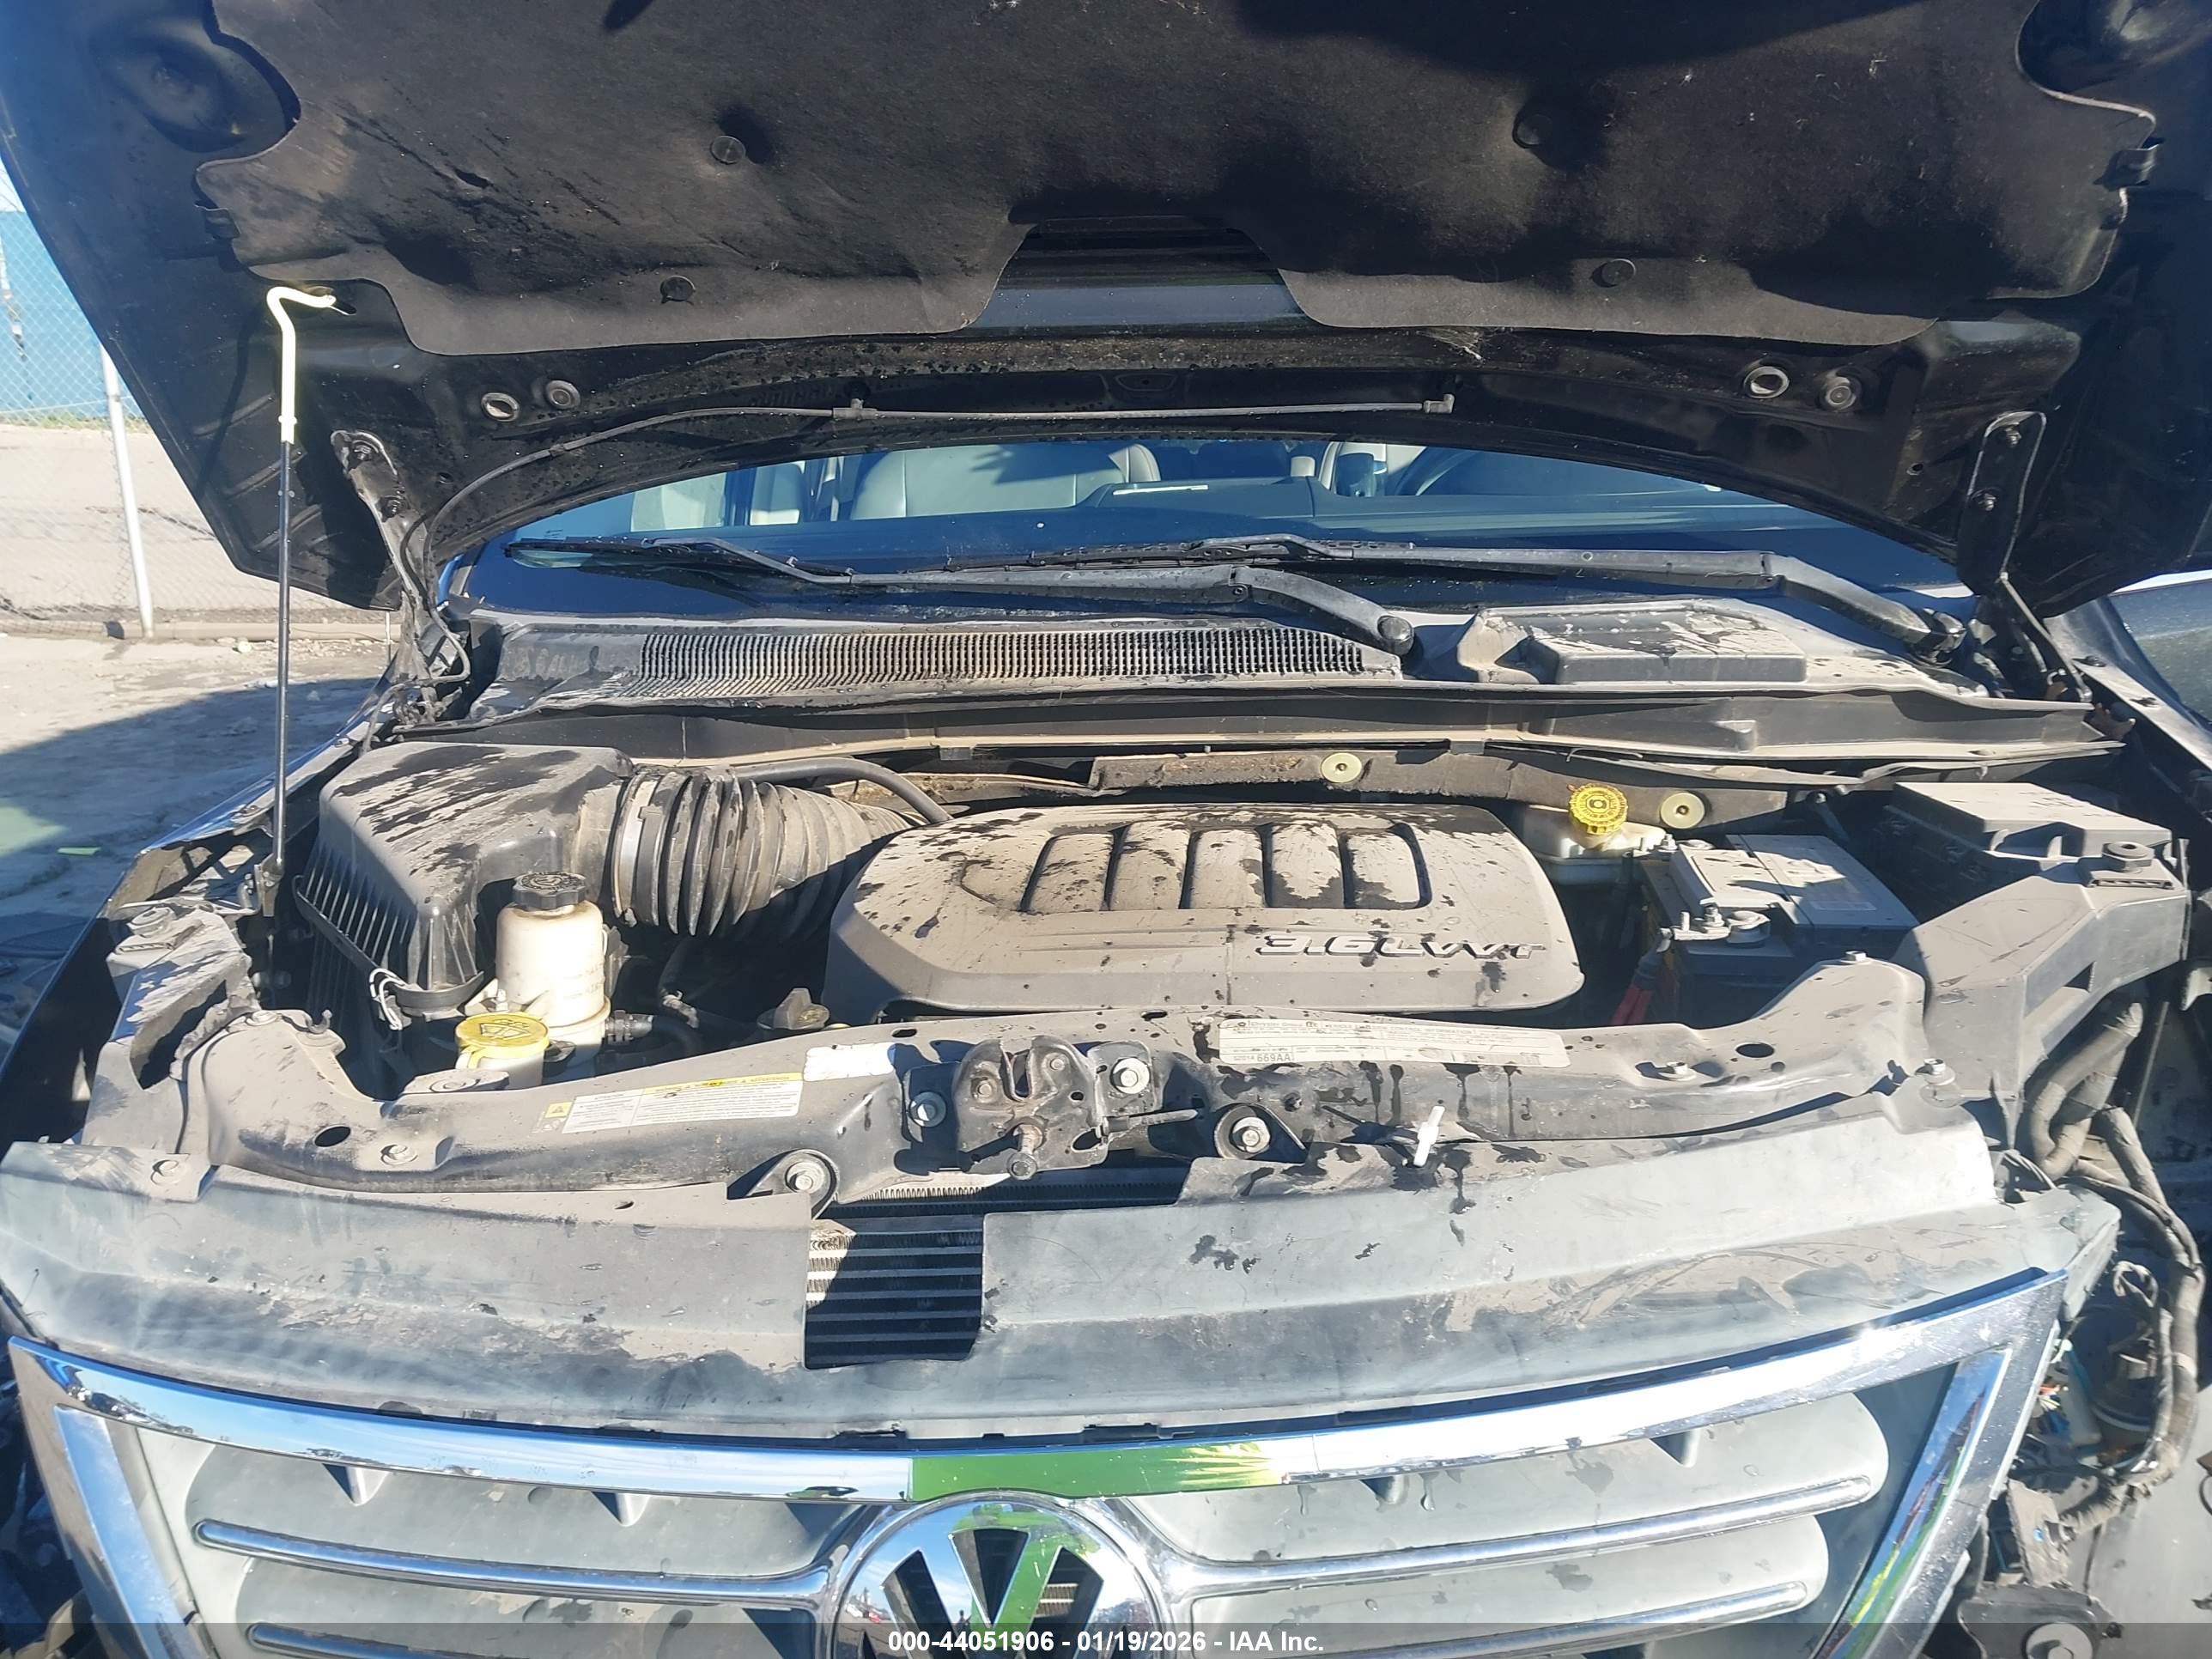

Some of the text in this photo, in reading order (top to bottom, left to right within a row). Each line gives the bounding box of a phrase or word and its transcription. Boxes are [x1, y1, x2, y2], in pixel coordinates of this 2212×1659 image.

[1255, 933, 1546, 959] 3.6L VVT
[1256, 1053, 1291, 1062] 669AA
